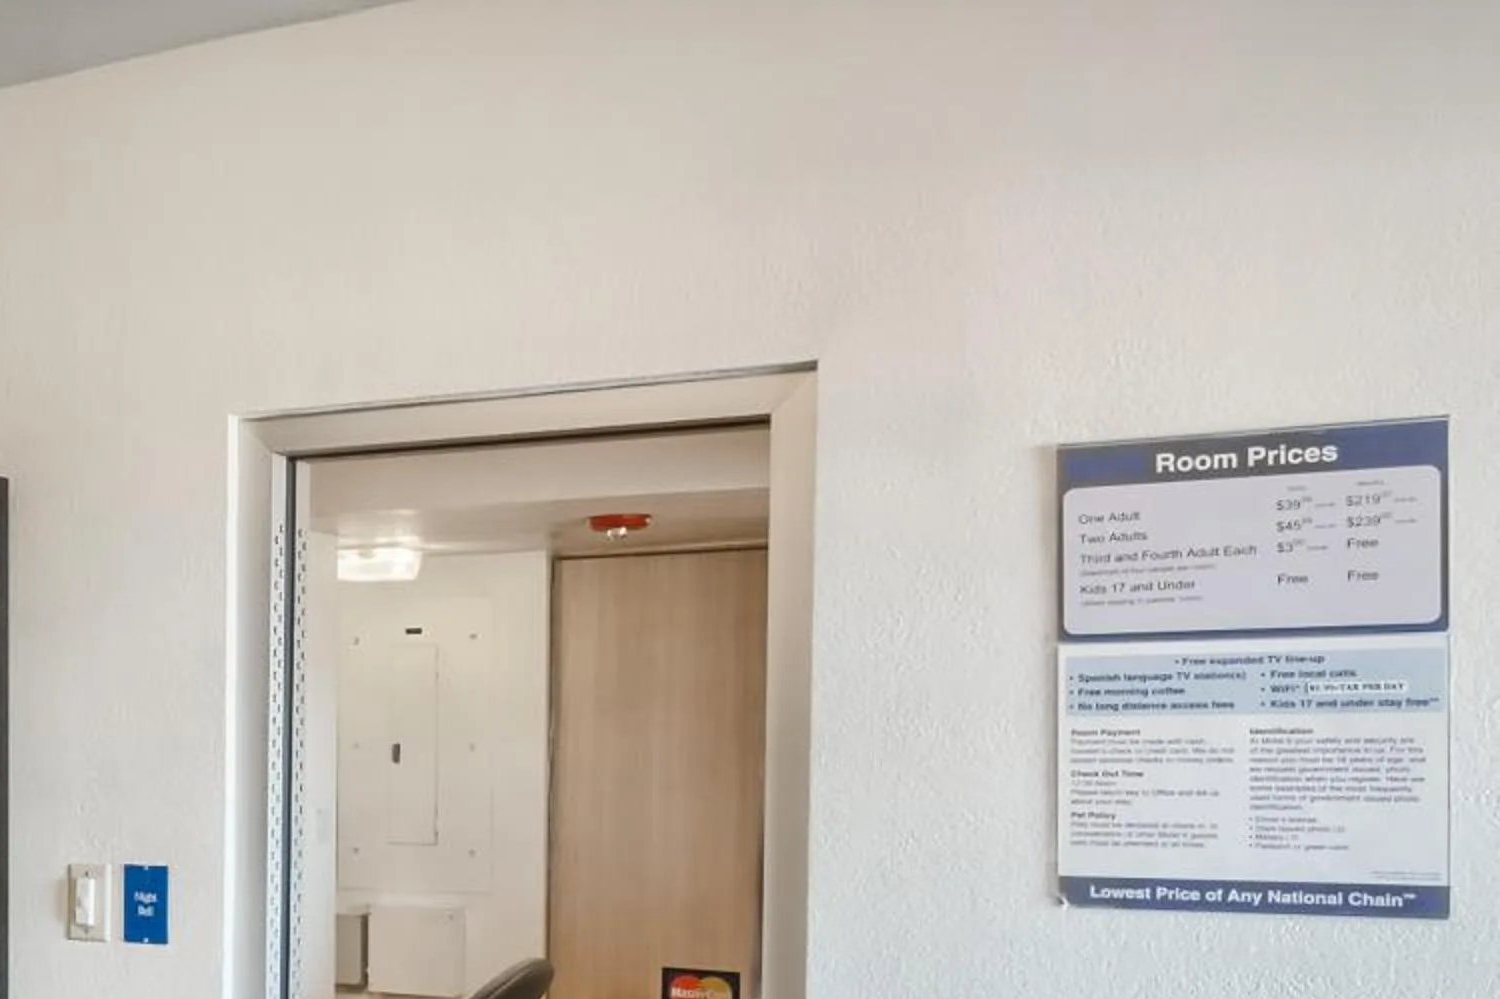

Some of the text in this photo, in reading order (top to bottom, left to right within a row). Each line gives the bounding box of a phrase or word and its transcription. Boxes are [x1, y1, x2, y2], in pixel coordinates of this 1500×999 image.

[1155, 443, 1340, 474] Room Prices
[1078, 511, 1141, 524] One Adult
[1080, 531, 1148, 544] Two Adults
[1347, 537, 1380, 549] Free
[1081, 544, 1258, 564] Third and Fourth Adult Each
[1277, 569, 1380, 585] Free Free
[1079, 579, 1196, 595] Kids 17 and Under
[1268, 655, 1283, 664] TV
[1176, 671, 1191, 681] TV
[1089, 885, 1151, 901] Lowest
[1156, 886, 1201, 902] Price
[1205, 888, 1225, 903] of
[1228, 888, 1264, 908] Any
[1267, 890, 1344, 907] National
